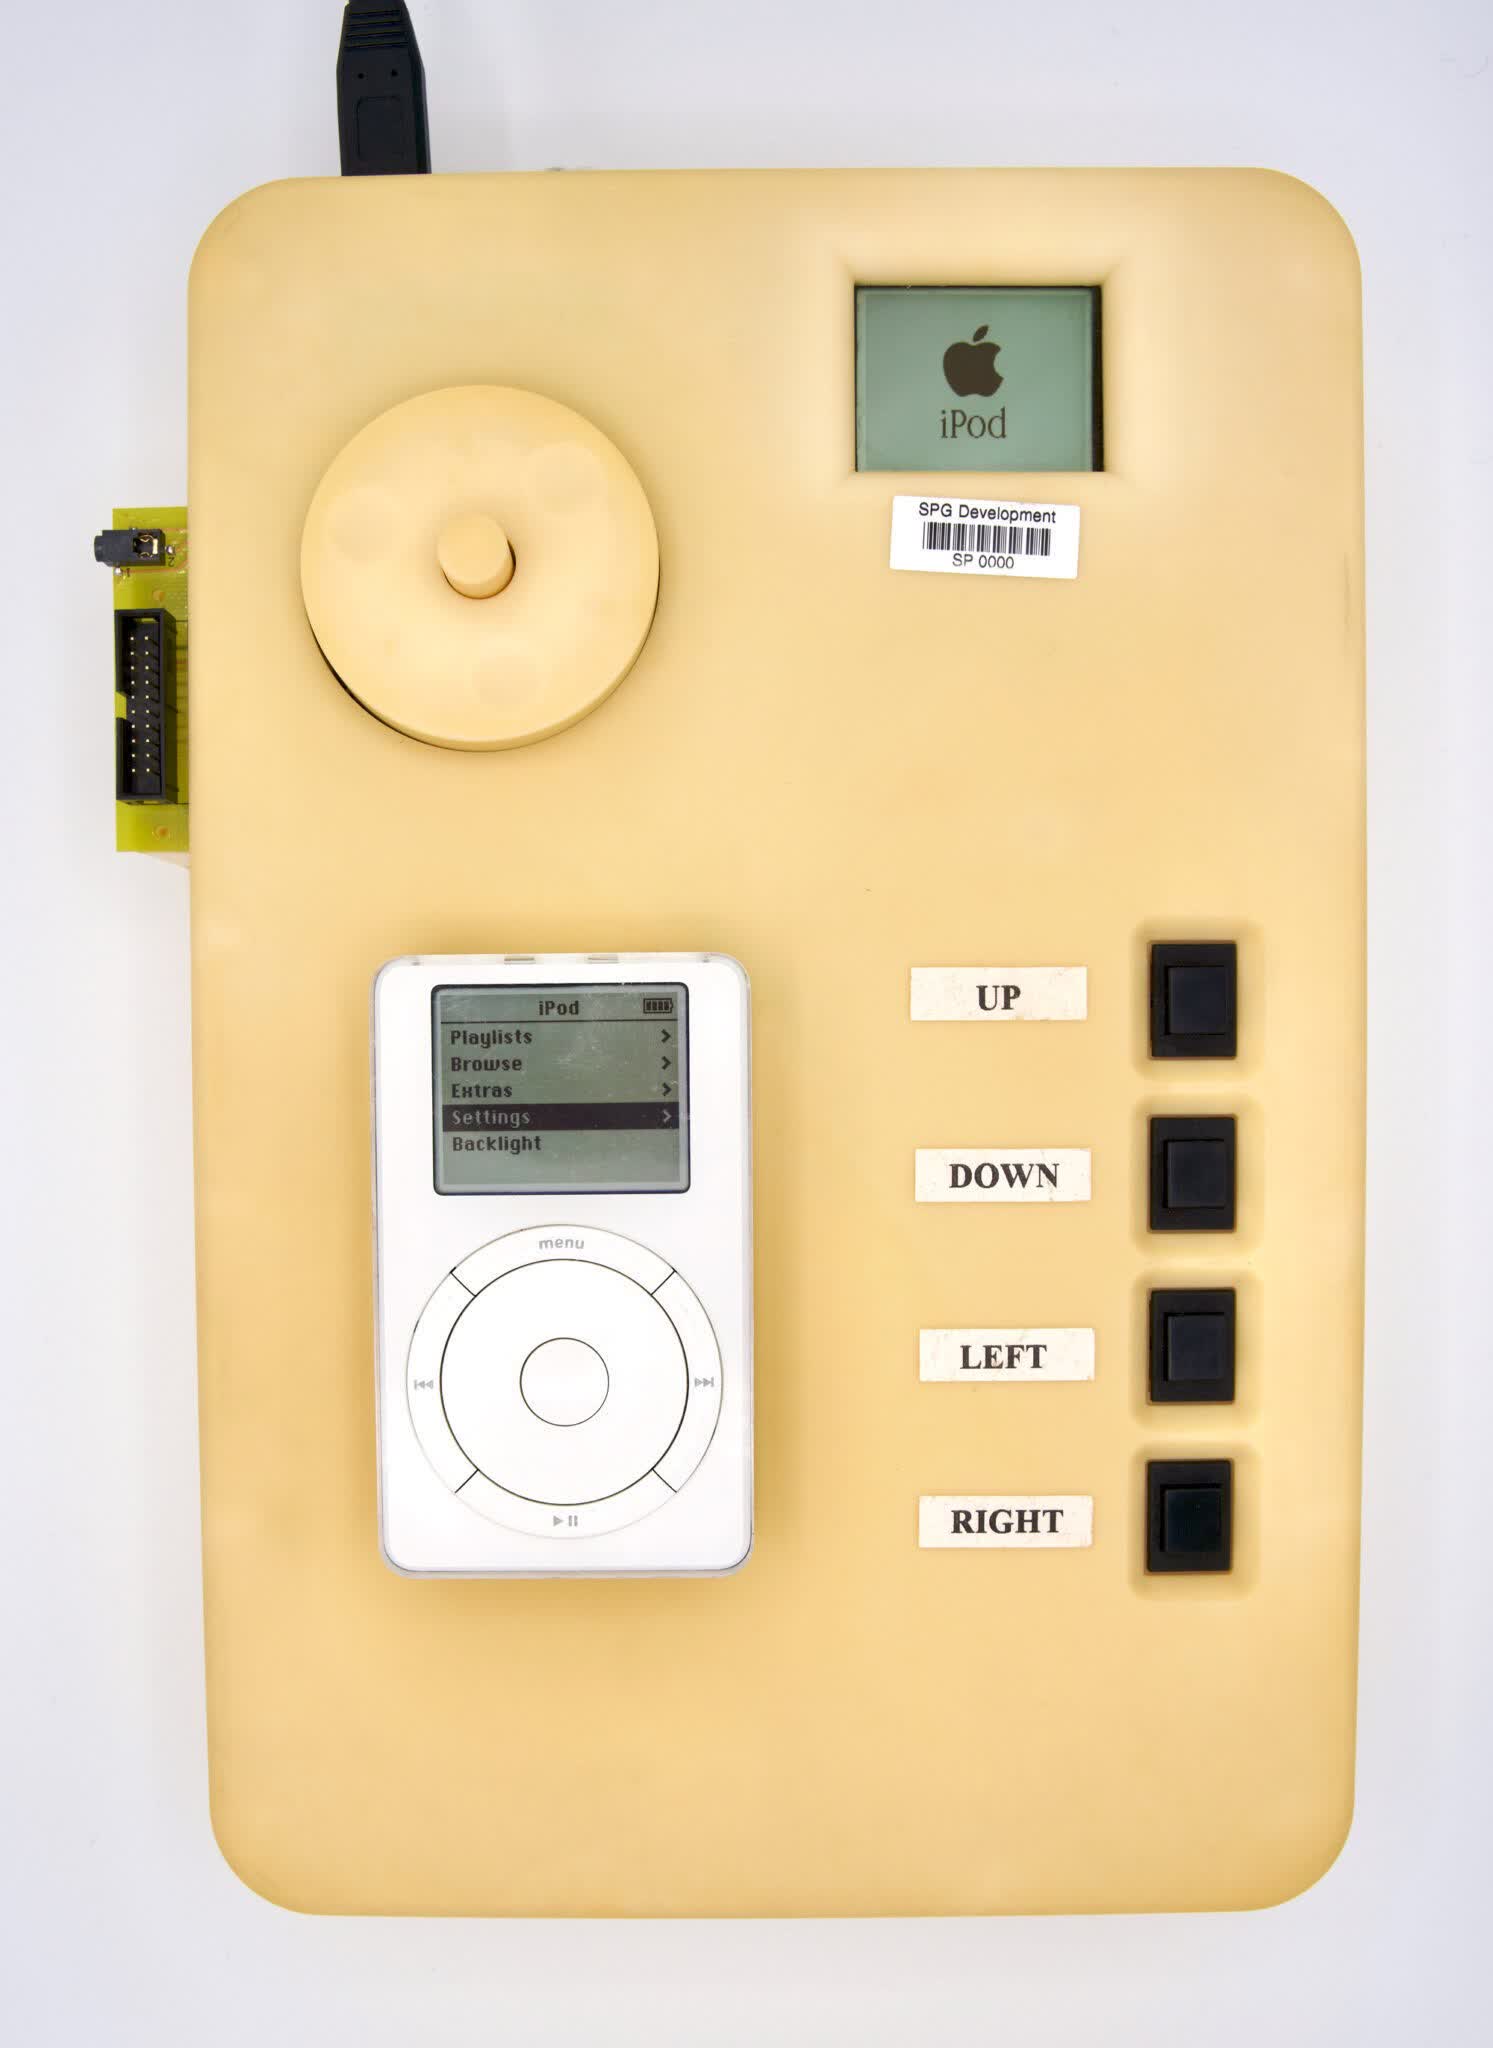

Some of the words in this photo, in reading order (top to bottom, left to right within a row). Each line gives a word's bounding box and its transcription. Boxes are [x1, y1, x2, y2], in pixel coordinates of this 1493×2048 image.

[940, 406, 1007, 439] iPod
[918, 501, 953, 518] SPG
[958, 504, 1056, 524] Development
[952, 552, 974, 567] SP
[978, 554, 1014, 569] 0000
[976, 984, 1022, 1012] UP
[538, 1000, 580, 1016] iPod
[450, 1029, 533, 1048] Playlists
[450, 1056, 523, 1073] Browse
[451, 1083, 513, 1099] Extras
[452, 1109, 531, 1127] Settings
[452, 1136, 542, 1155] Backlight
[948, 1162, 1060, 1190] DOWN
[538, 1236, 585, 1251] menu
[959, 1344, 1048, 1370] LEFT
[950, 1509, 1065, 1535] RIGHT
